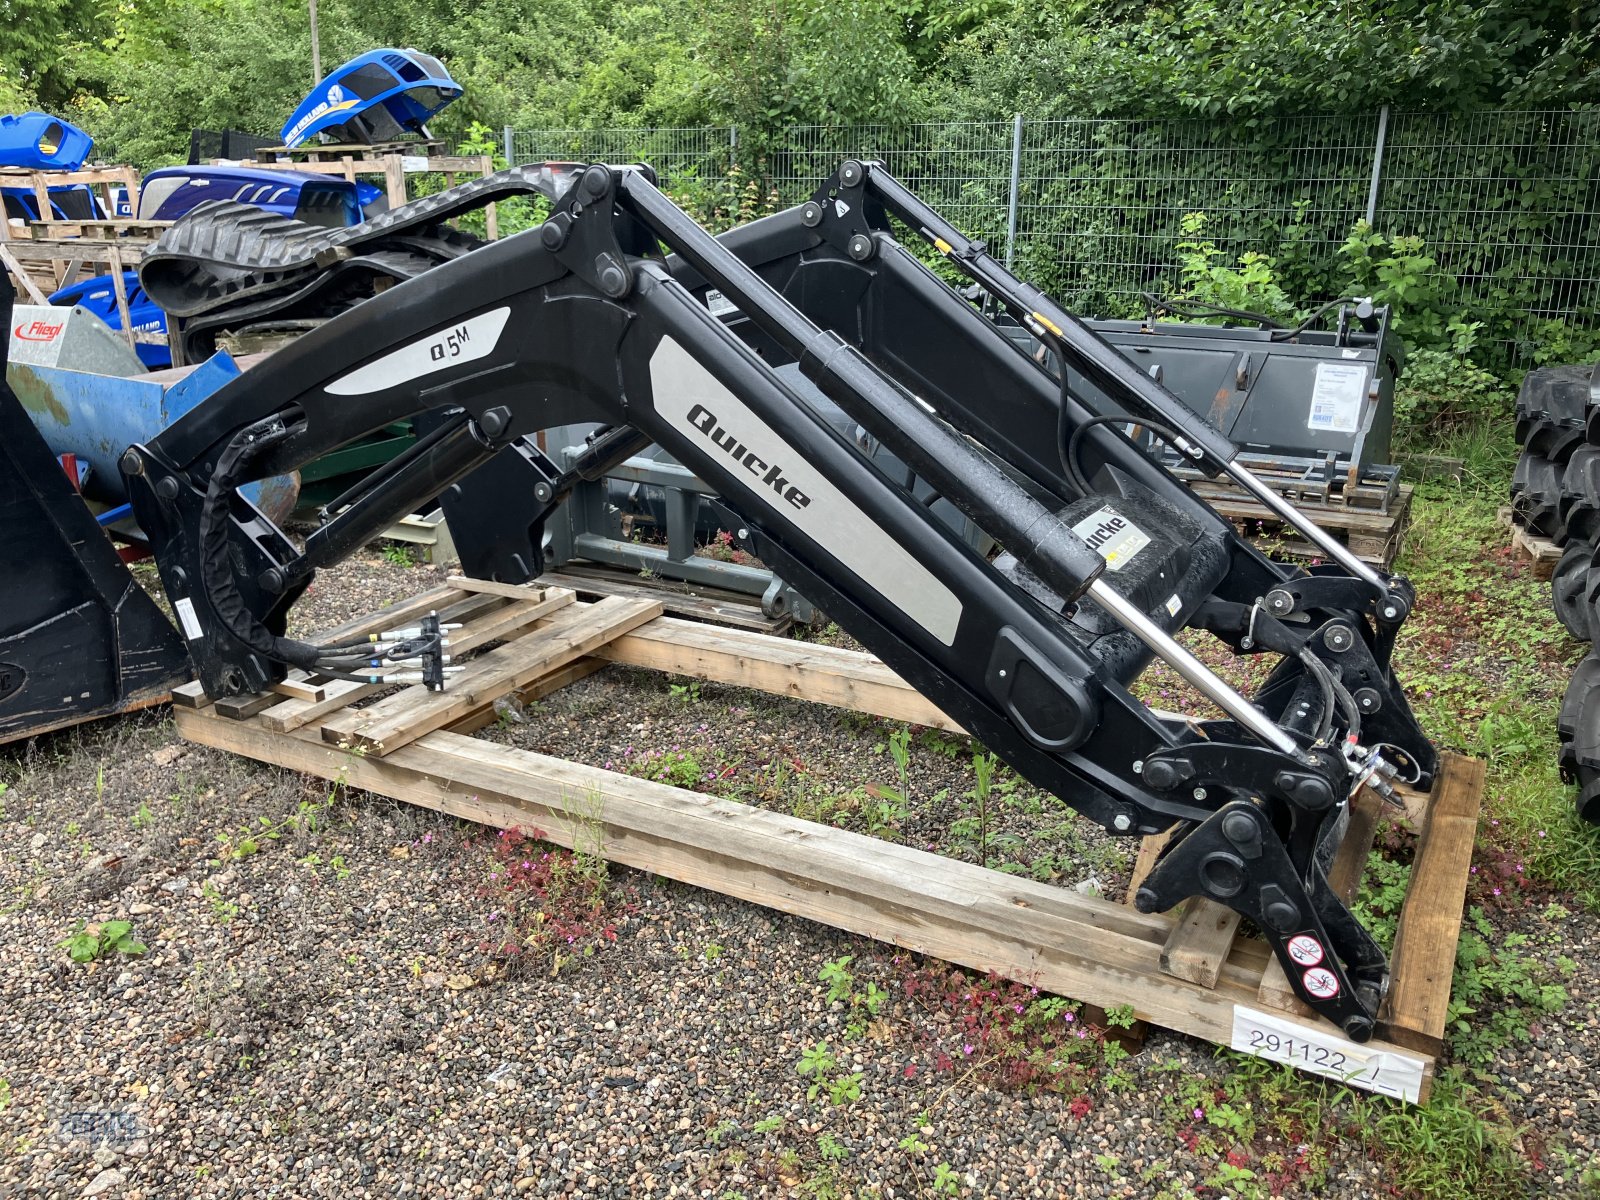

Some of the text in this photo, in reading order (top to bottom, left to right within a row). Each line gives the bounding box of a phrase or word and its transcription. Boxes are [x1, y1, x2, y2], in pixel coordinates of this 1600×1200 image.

[298, 102, 328, 129] HOLLAND
[28, 321, 64, 339] Fliegl
[686, 403, 812, 510] Quicke
[1085, 517, 1127, 551] uicke
[1249, 1029, 1346, 1072] 291122
